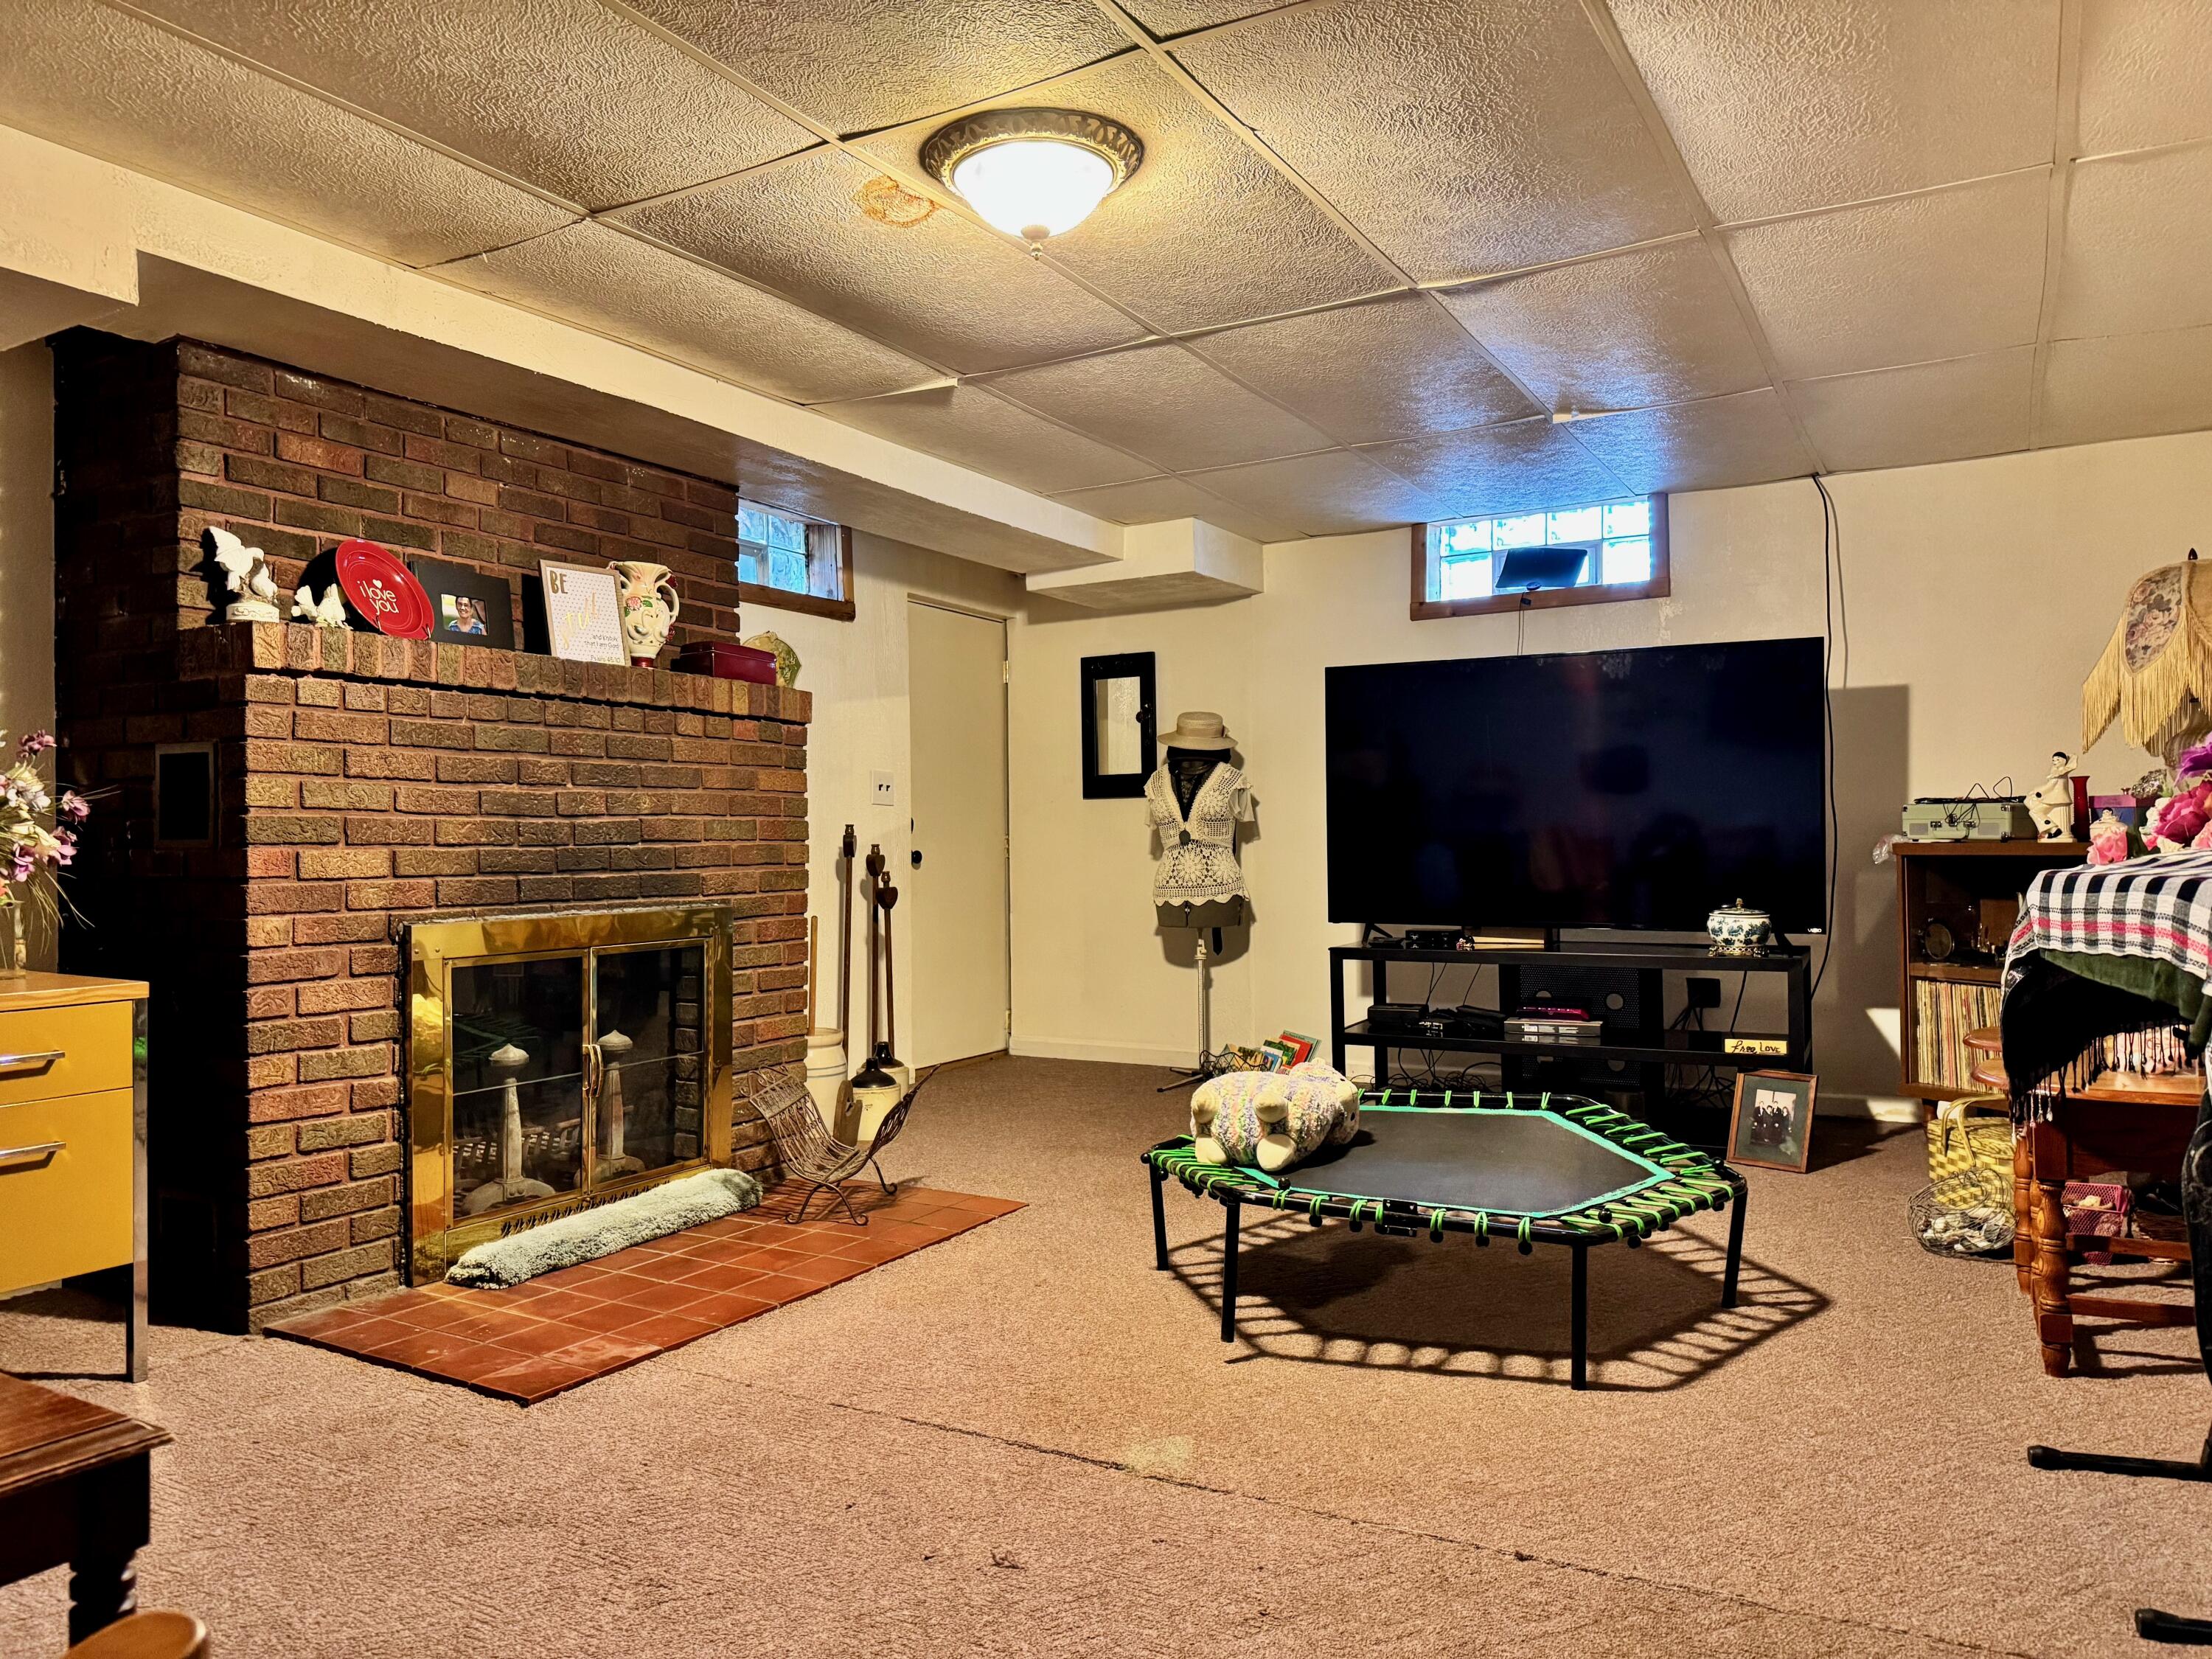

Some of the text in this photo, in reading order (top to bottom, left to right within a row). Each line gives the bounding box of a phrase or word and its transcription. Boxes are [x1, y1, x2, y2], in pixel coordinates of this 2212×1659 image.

[357, 580, 396, 602] i love
[550, 570, 568, 594] BE
[369, 598, 399, 615] you
